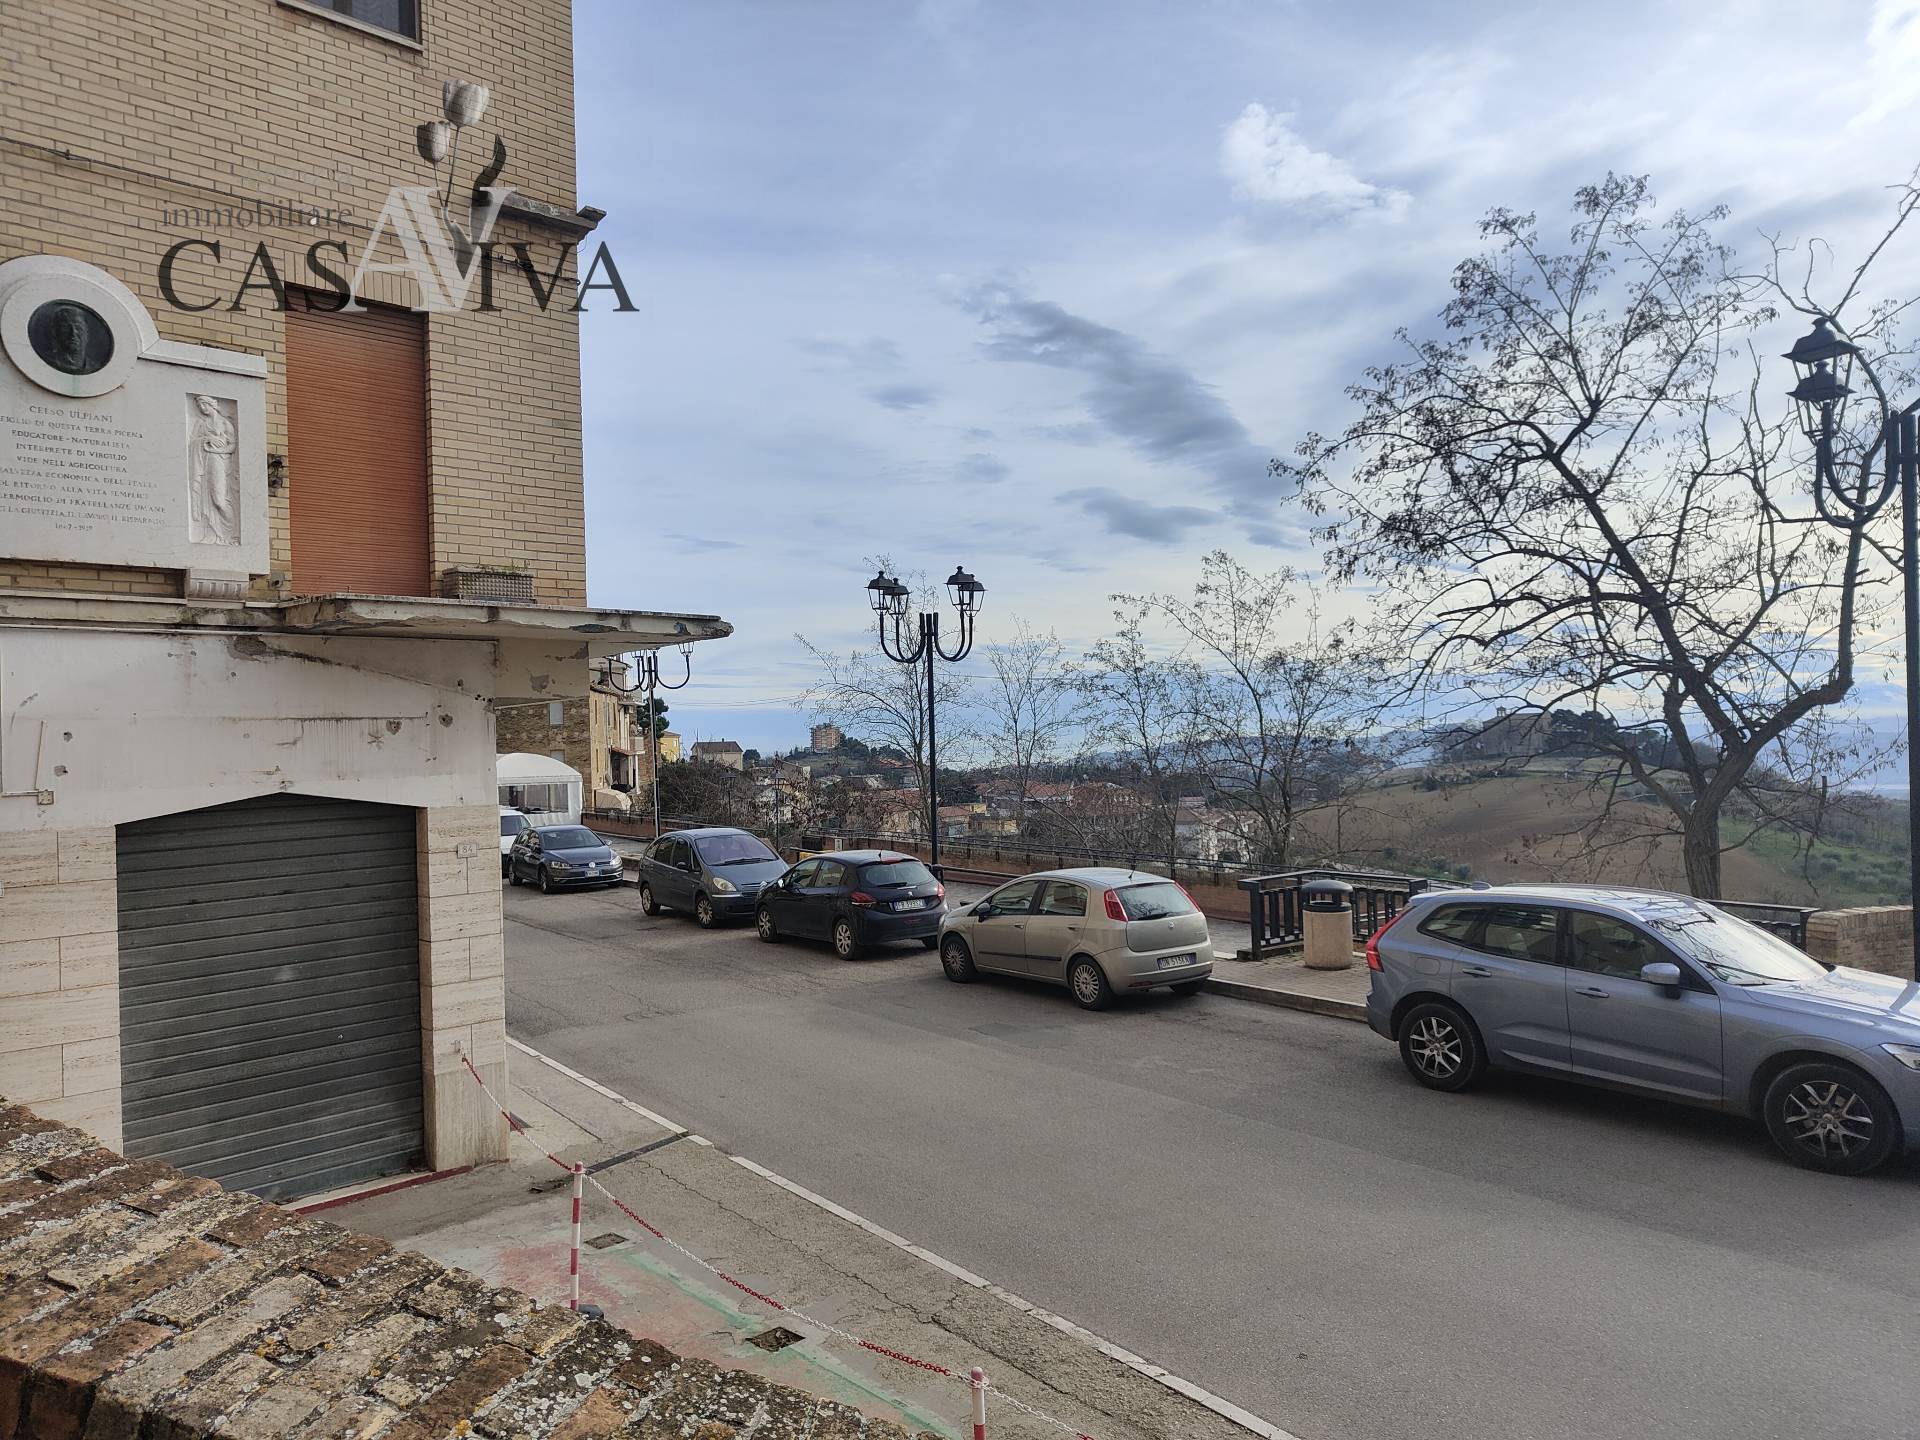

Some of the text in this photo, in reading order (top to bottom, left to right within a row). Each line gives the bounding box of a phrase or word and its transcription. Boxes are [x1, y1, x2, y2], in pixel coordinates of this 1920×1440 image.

[29, 405, 113, 423] CELSO ULPIANI
[0, 415, 144, 439] FIGLIO DI QUESTA TERRA PICENA
[16, 442, 128, 461] INTERPRETE DI VIRGILIO
[17, 455, 39, 464] VIDE
[45, 471, 100, 482] ECONOMICA
[62, 486, 83, 494] ALLA
[86, 488, 107, 496] VITA
